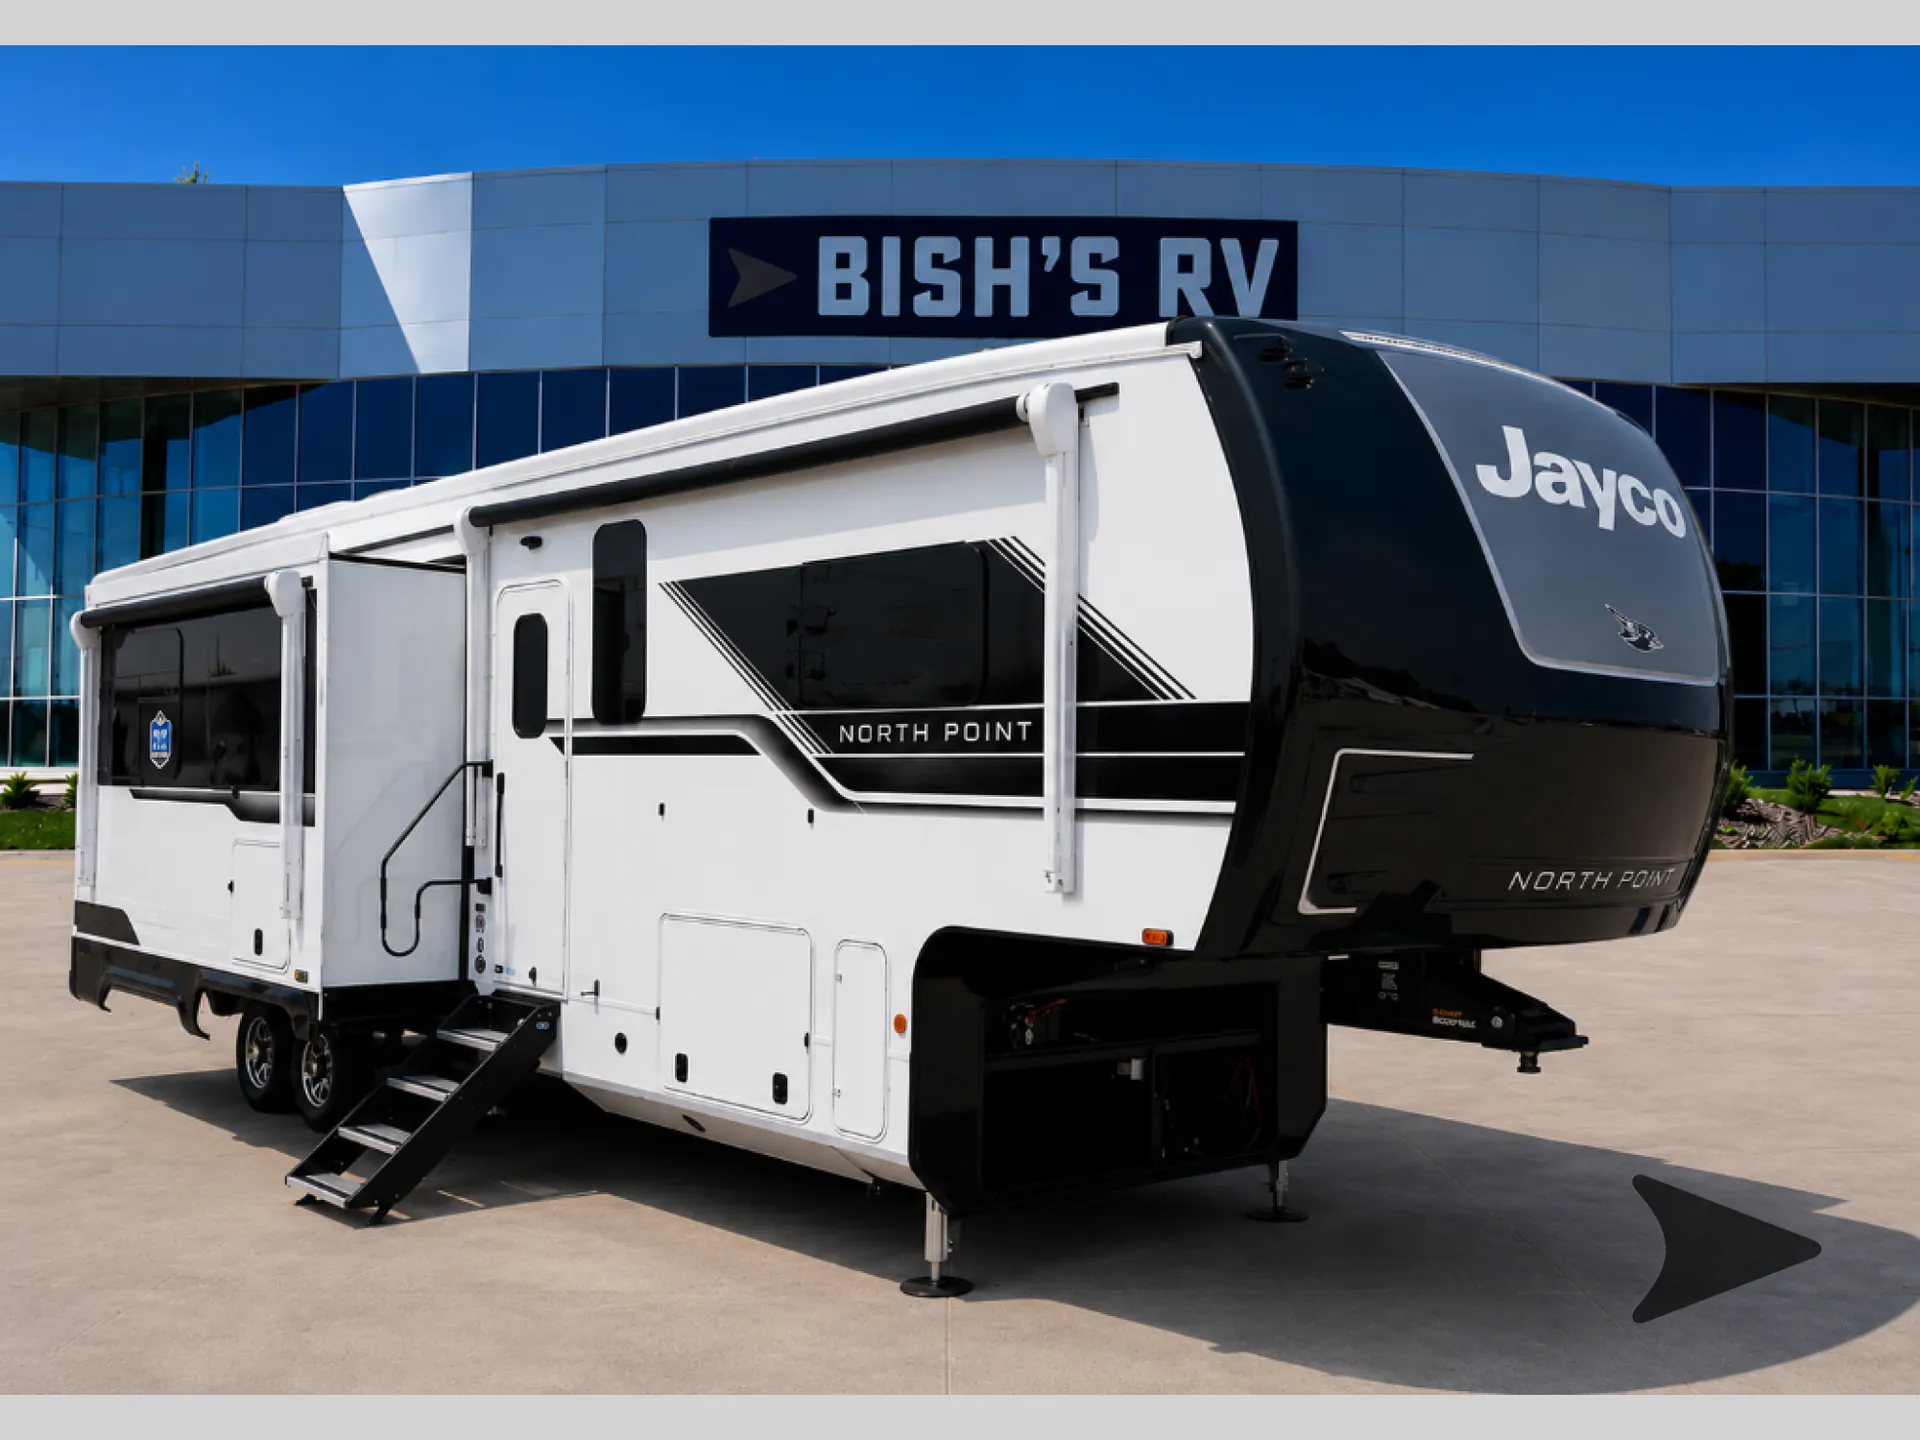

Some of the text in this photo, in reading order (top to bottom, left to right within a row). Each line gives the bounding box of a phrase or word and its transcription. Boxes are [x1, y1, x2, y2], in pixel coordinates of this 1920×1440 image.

[817, 235, 1280, 318] BISH'S RV
[1475, 425, 1687, 539] Jayco
[839, 721, 1033, 743] NORTH POINT
[1507, 868, 1676, 891] NORTH POINT
